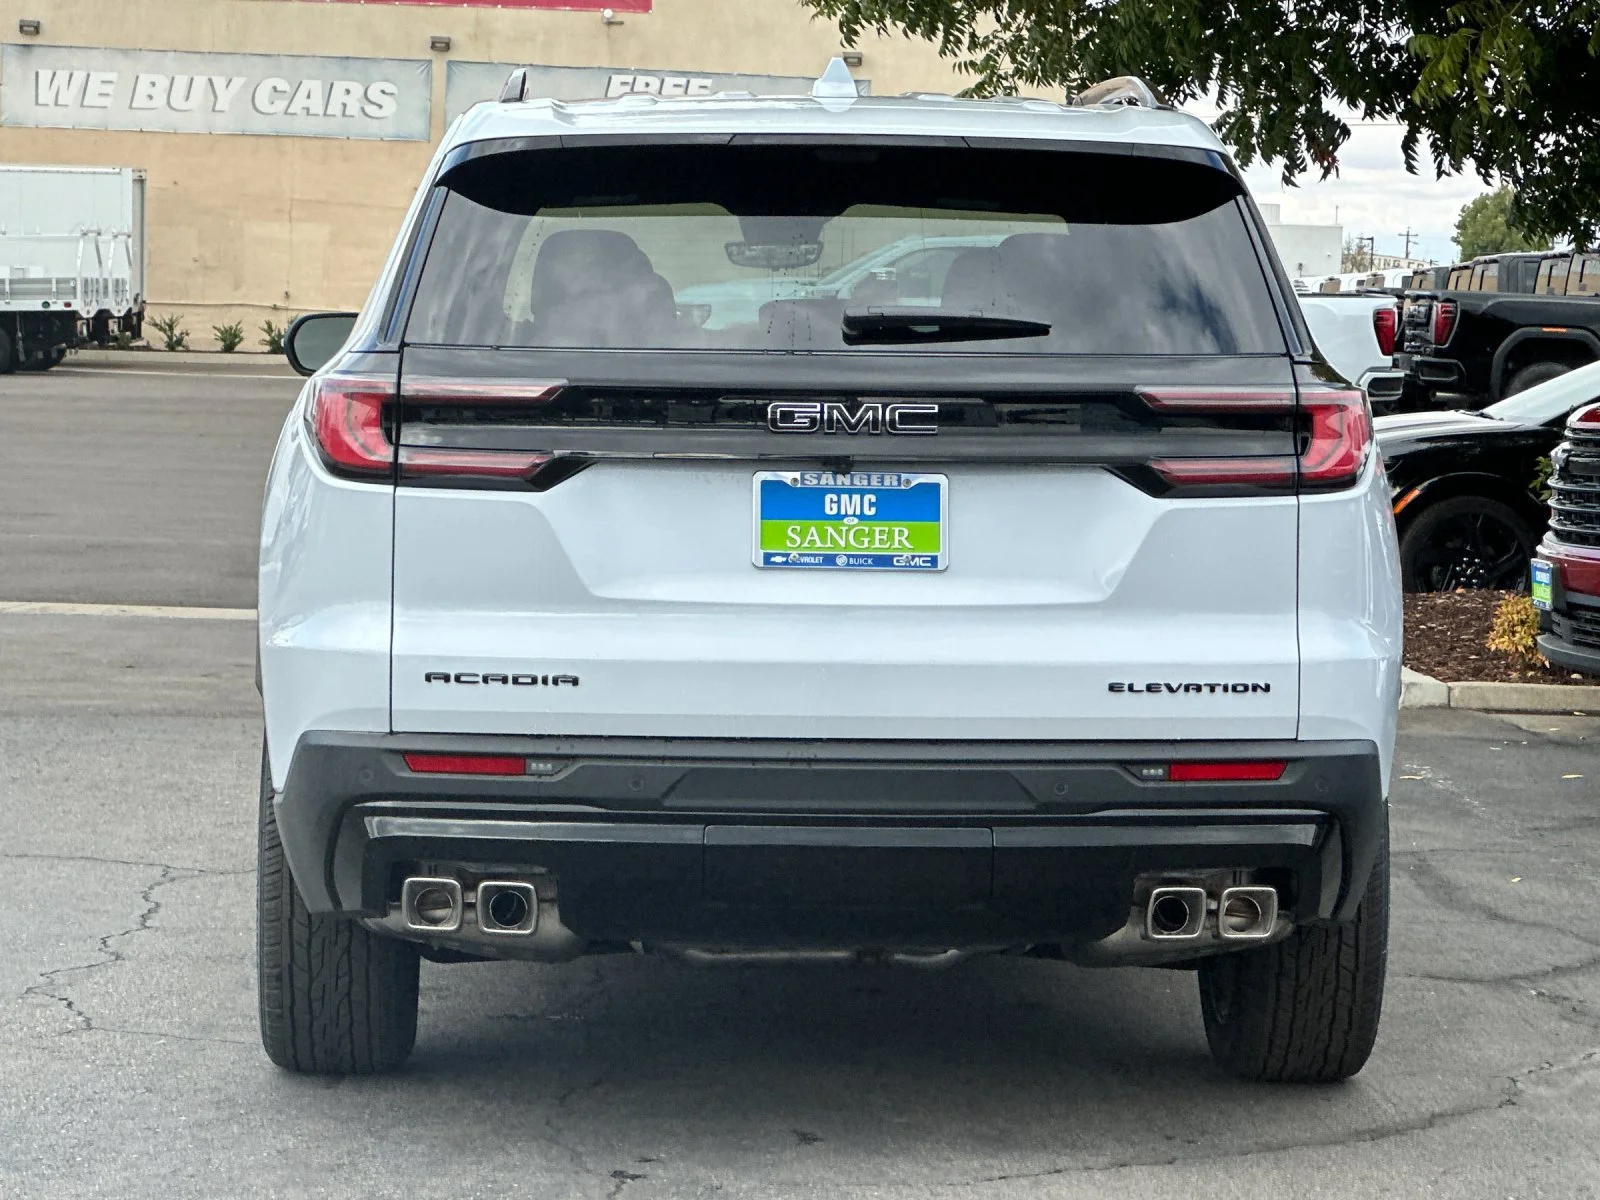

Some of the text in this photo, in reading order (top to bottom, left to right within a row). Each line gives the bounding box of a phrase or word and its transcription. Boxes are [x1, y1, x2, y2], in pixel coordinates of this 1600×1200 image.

[35, 69, 399, 119] WE BUY CARS
[767, 402, 939, 436] GMC
[803, 472, 900, 487] SANGER
[824, 493, 877, 516] GMC
[786, 525, 914, 549] SANGER
[849, 557, 874, 565] BUICK
[425, 671, 580, 687] ACADIA
[1107, 682, 1271, 694] ELEVATION
